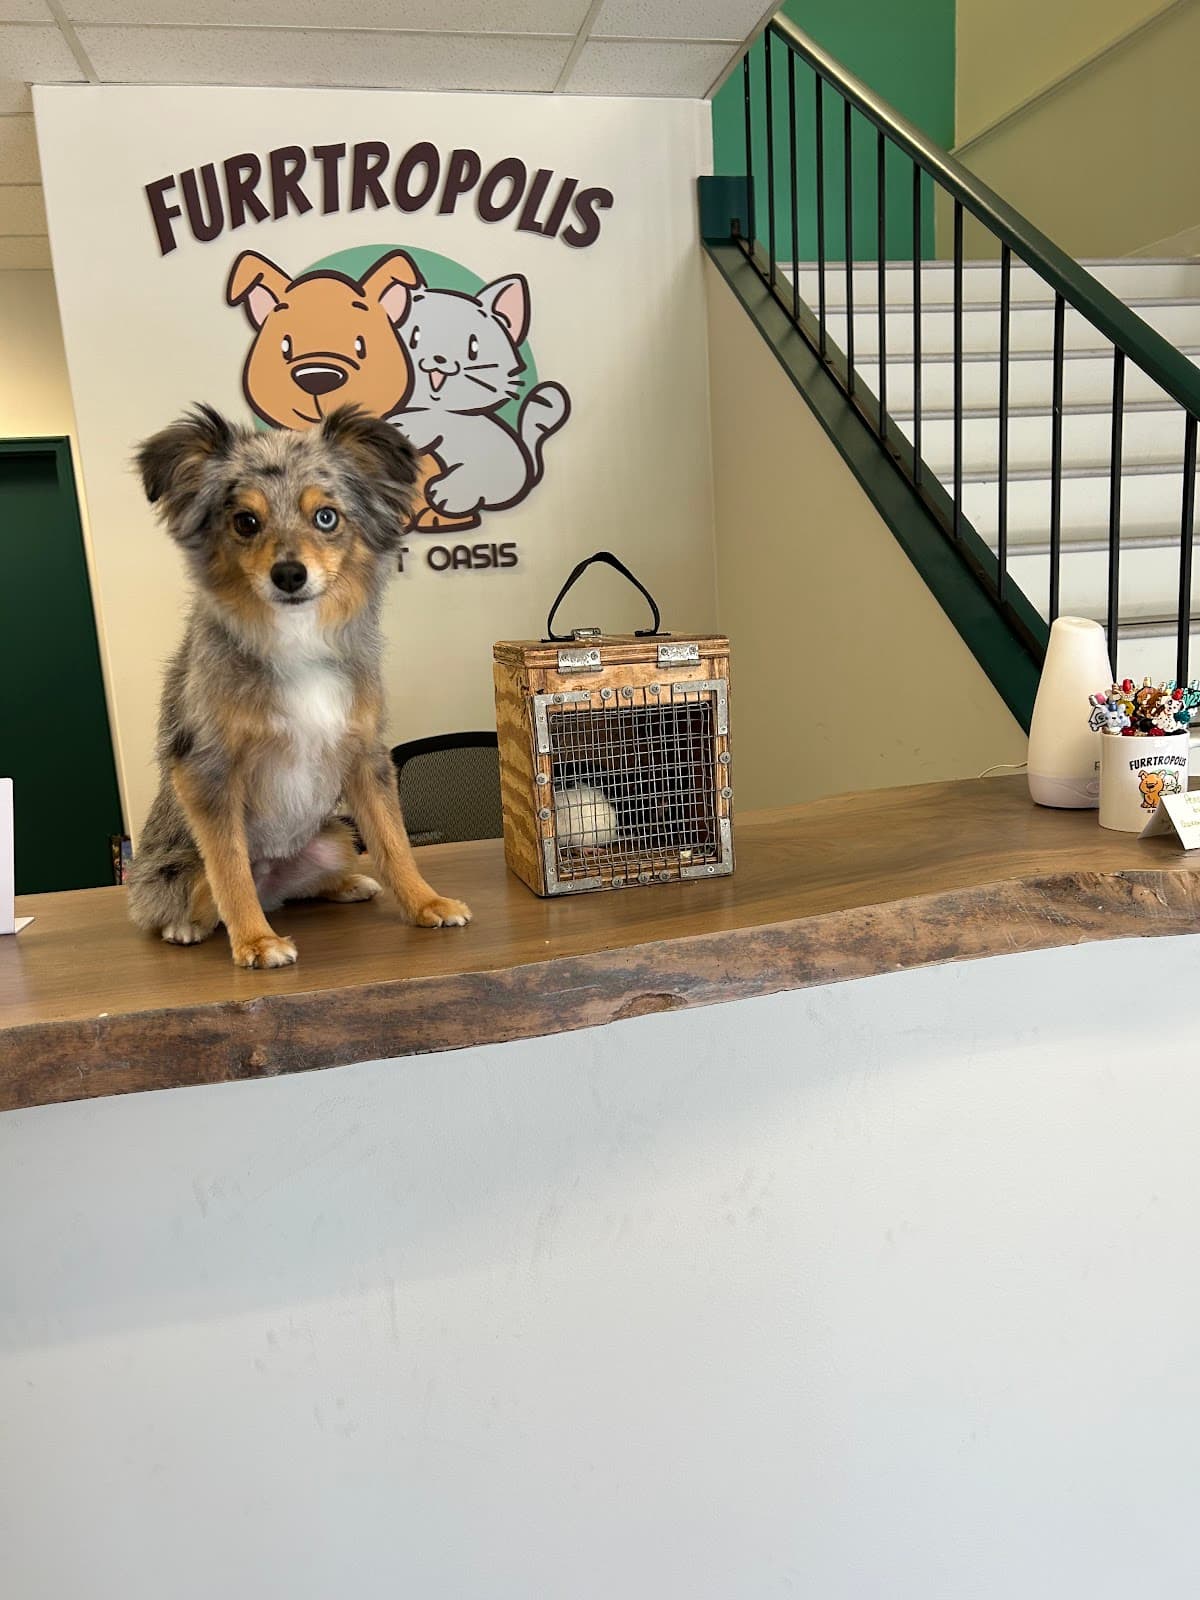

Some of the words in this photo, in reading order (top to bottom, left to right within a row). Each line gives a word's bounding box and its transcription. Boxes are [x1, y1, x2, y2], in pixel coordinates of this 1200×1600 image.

[144, 140, 614, 256] FURRTROPOLIS
[427, 542, 519, 572] OASIS
[1129, 755, 1187, 771] FURRTROPOLIS
